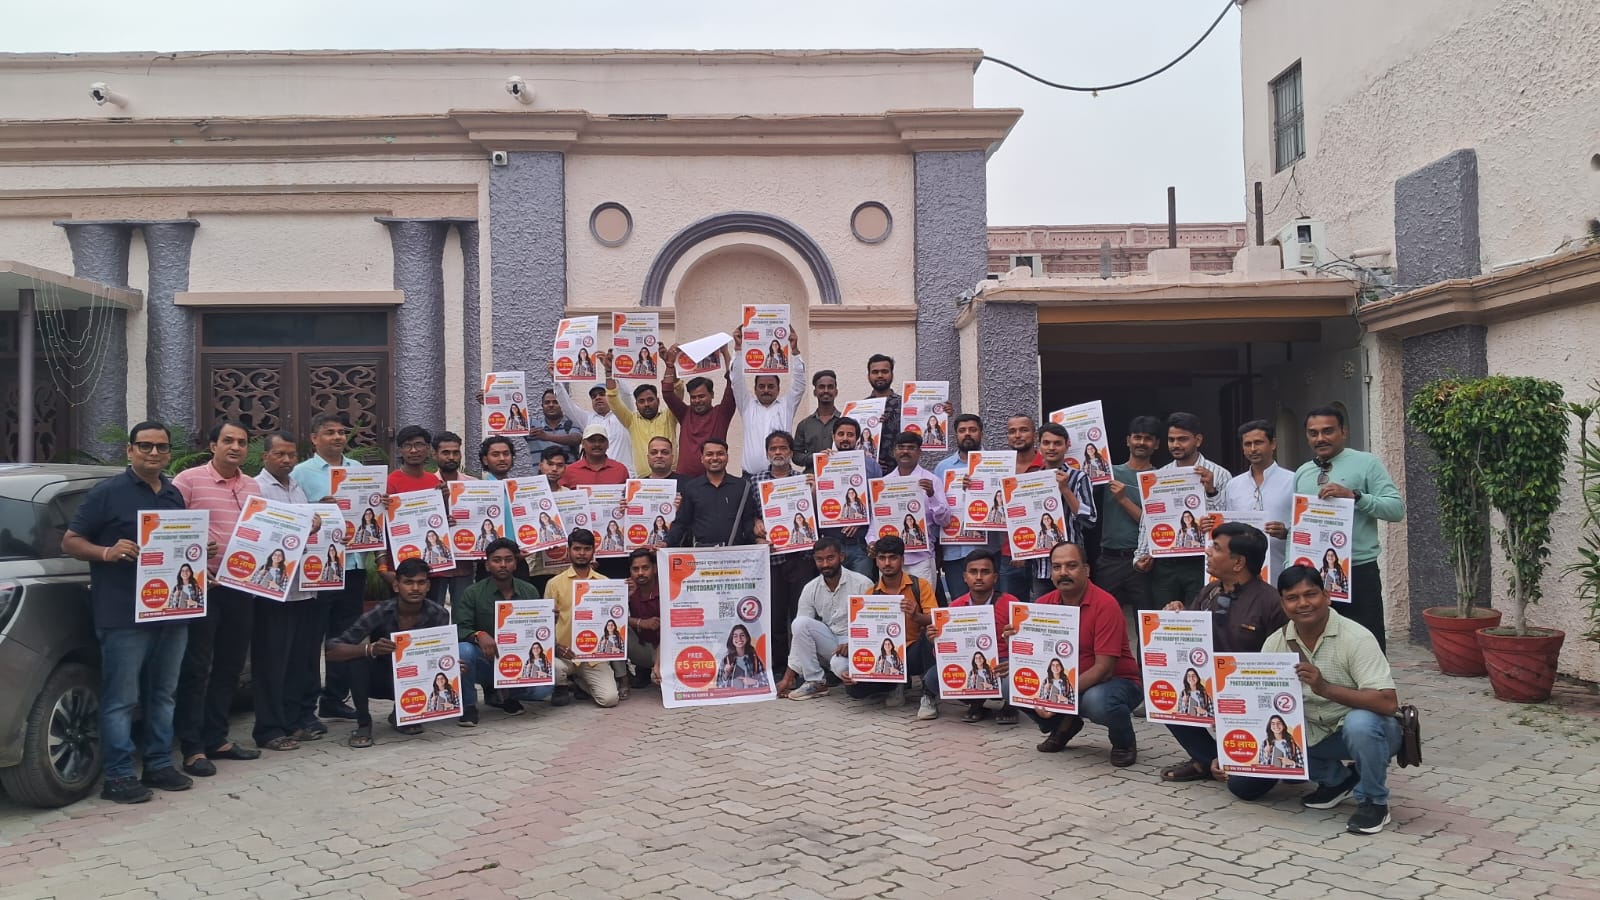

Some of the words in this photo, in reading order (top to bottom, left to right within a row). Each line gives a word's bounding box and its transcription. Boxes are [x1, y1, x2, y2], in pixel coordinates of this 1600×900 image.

[677, 660, 690, 670] ₹5
[692, 659, 714, 669] लाख
[1225, 741, 1235, 749] ₹5
